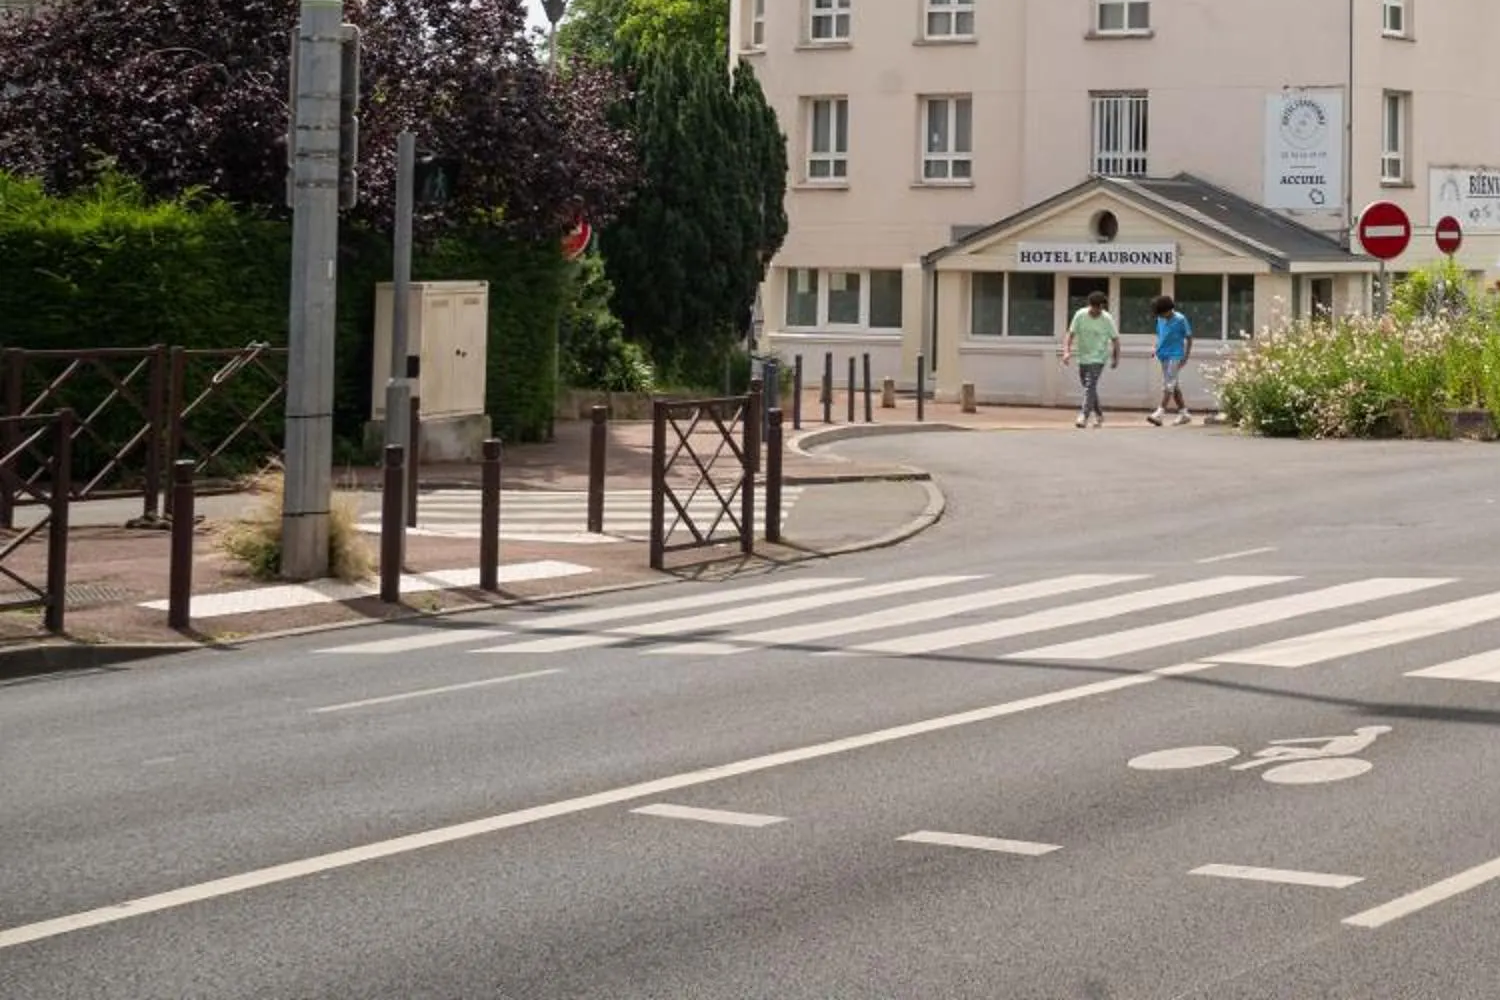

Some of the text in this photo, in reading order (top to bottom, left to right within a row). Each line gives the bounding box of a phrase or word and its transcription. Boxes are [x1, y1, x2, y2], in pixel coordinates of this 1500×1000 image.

[1280, 175, 1327, 185] ACCUEIL
[1020, 251, 1173, 266] HOTEL L'EAUBONNE
